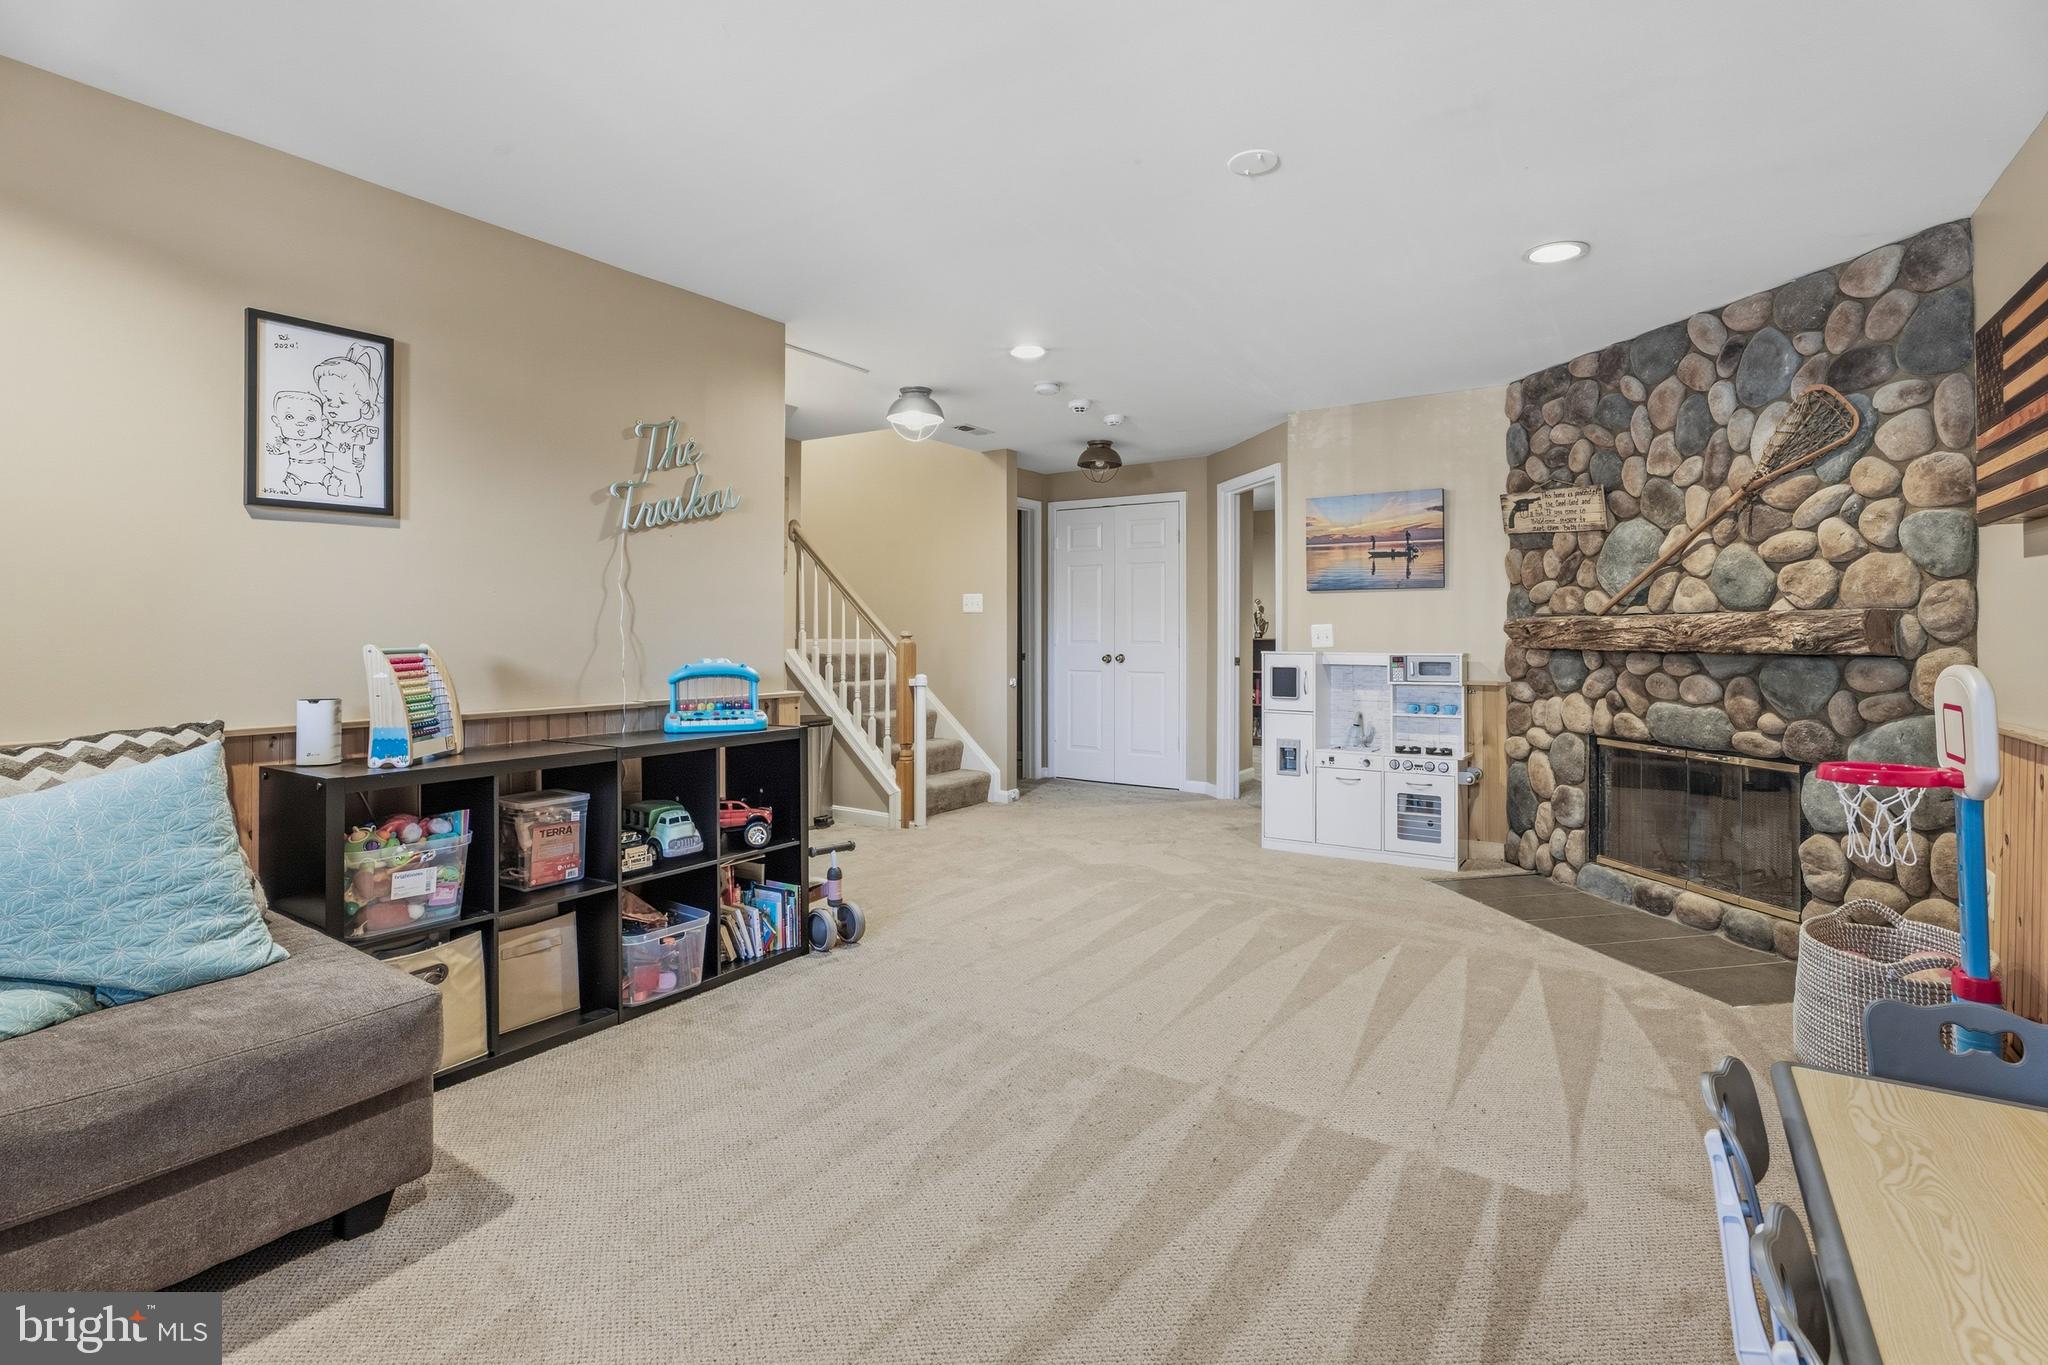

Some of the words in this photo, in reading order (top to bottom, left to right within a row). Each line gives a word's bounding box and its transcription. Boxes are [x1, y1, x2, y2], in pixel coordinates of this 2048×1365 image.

[634, 417, 705, 471] The
[609, 473, 742, 530] Troskas
[539, 825, 573, 838] TERRA
